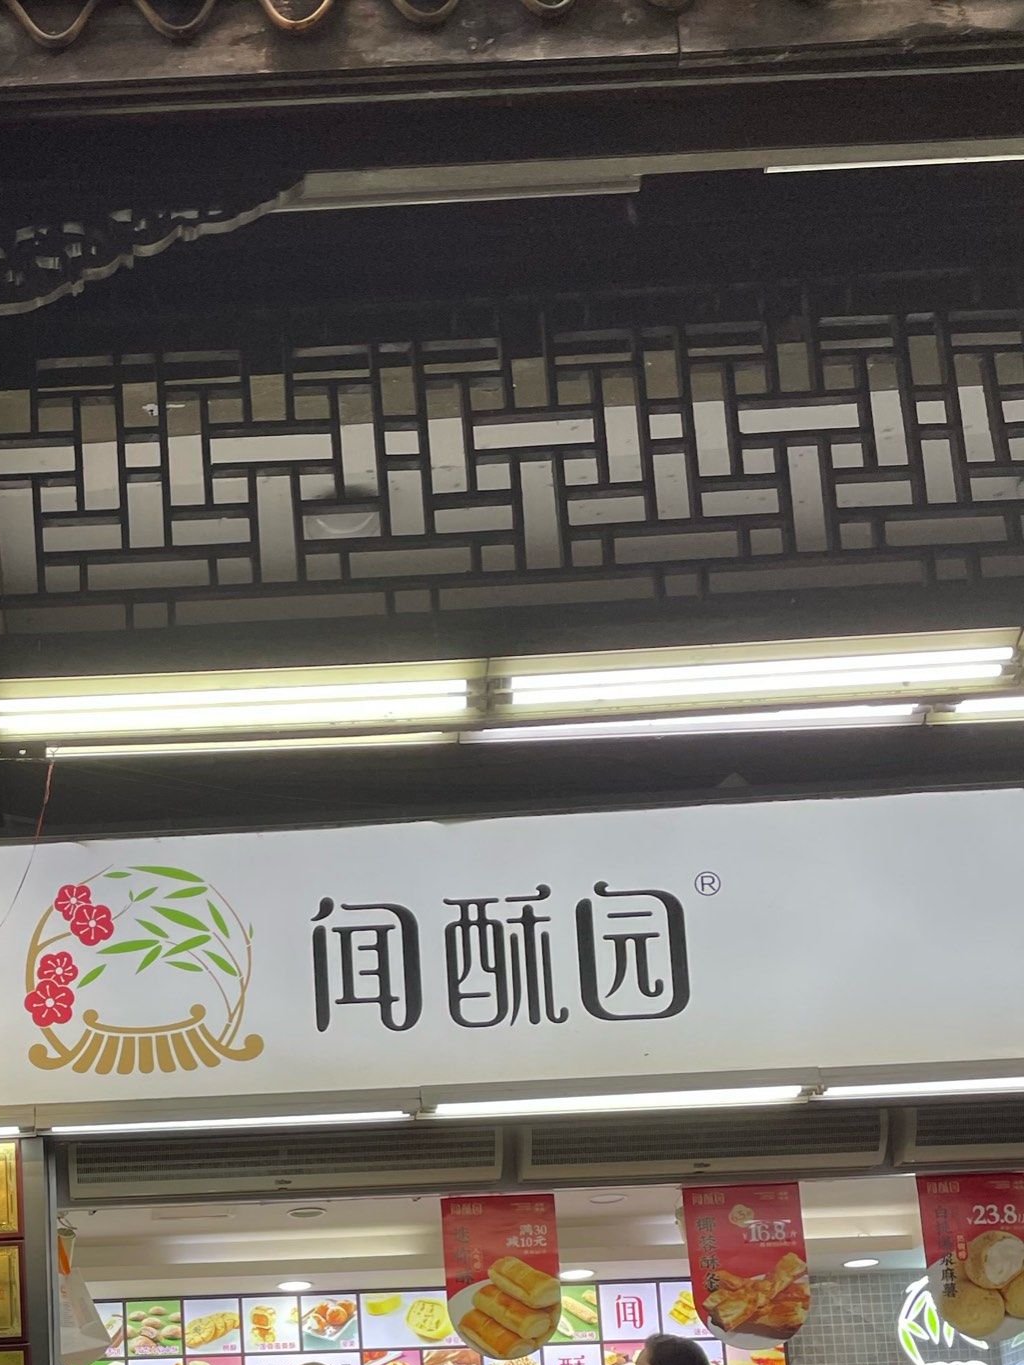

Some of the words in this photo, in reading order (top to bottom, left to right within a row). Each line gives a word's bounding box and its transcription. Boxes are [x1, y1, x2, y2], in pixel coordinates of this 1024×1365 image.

[311, 880, 690, 1032] 闻酥园
[967, 1203, 1024, 1225] ¥23.8/
[614, 1294, 645, 1330] 闻
